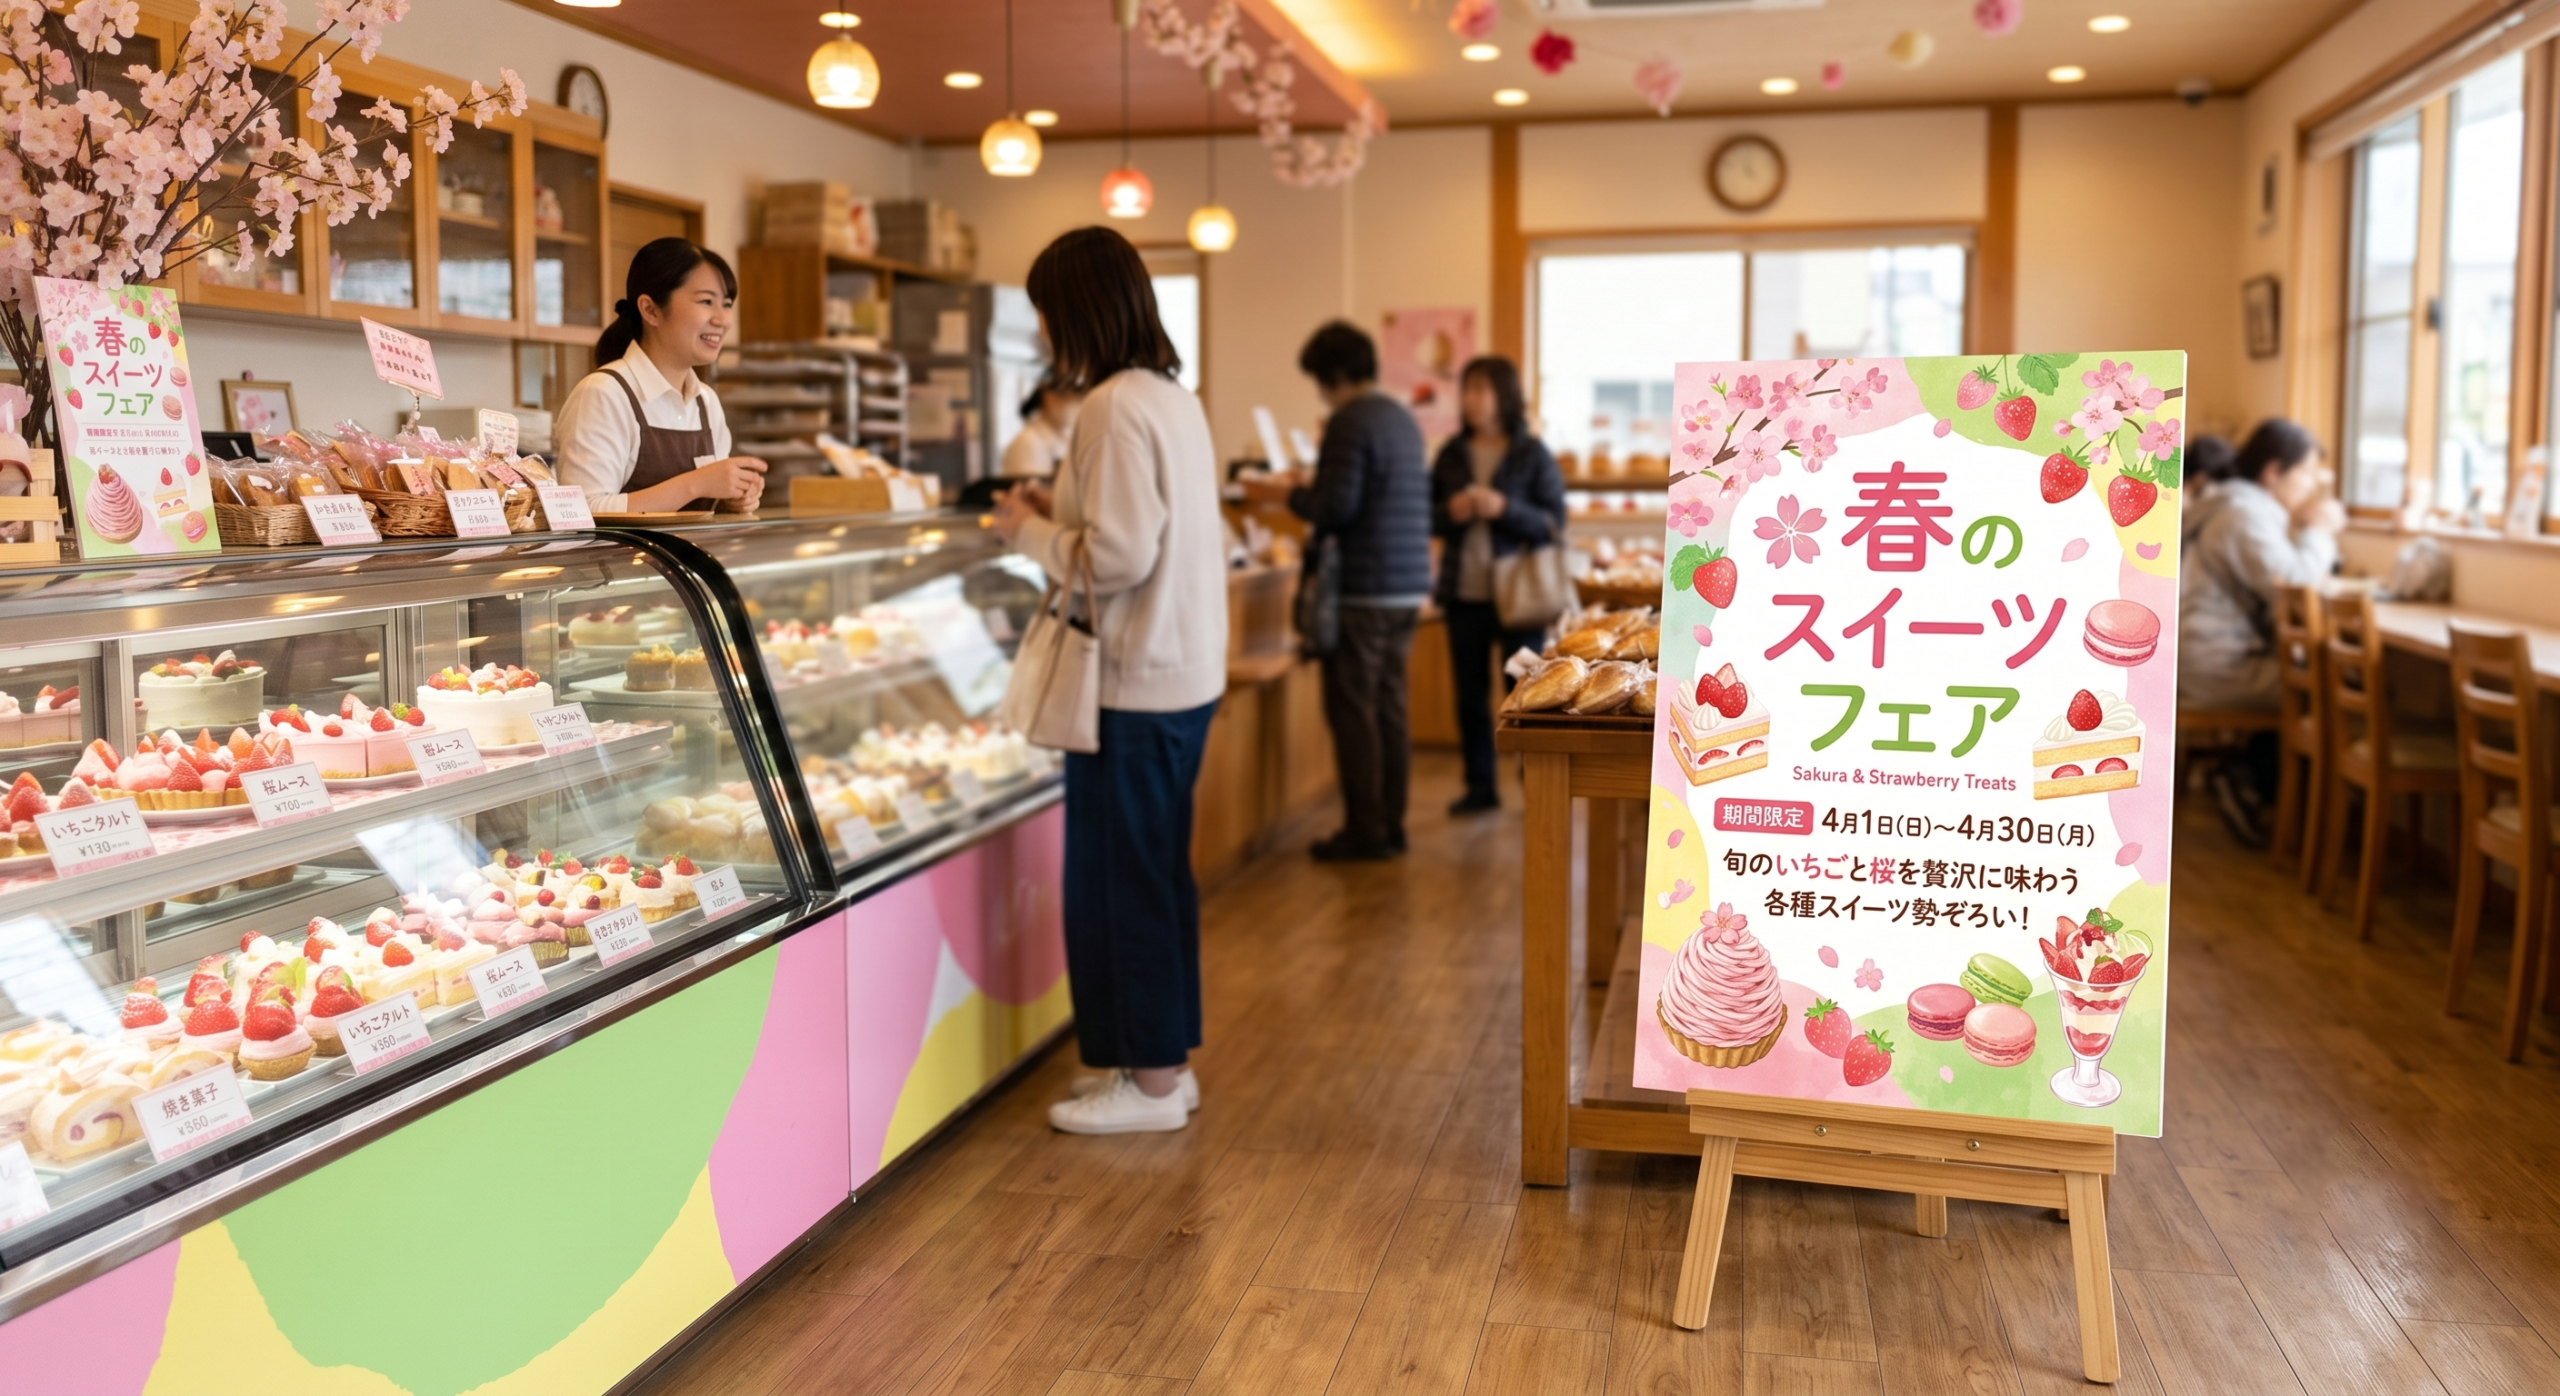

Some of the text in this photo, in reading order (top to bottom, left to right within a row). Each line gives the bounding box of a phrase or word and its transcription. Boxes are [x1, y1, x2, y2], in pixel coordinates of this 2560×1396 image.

[93, 316, 146, 356] 春の
[83, 360, 163, 388] スイーツ
[97, 392, 154, 416] フェア
[1841, 461, 2023, 572] 春の
[1764, 587, 2067, 669] スイーツ
[1800, 684, 2020, 758] フェア
[1793, 765, 2017, 792] Sakura & Strawberry Treats
[1721, 803, 1805, 829] 期間限定
[1722, 848, 2079, 895] 旬のいちごと桜を贅沢に味わう
[162, 1081, 219, 1119] 焼き菓子
